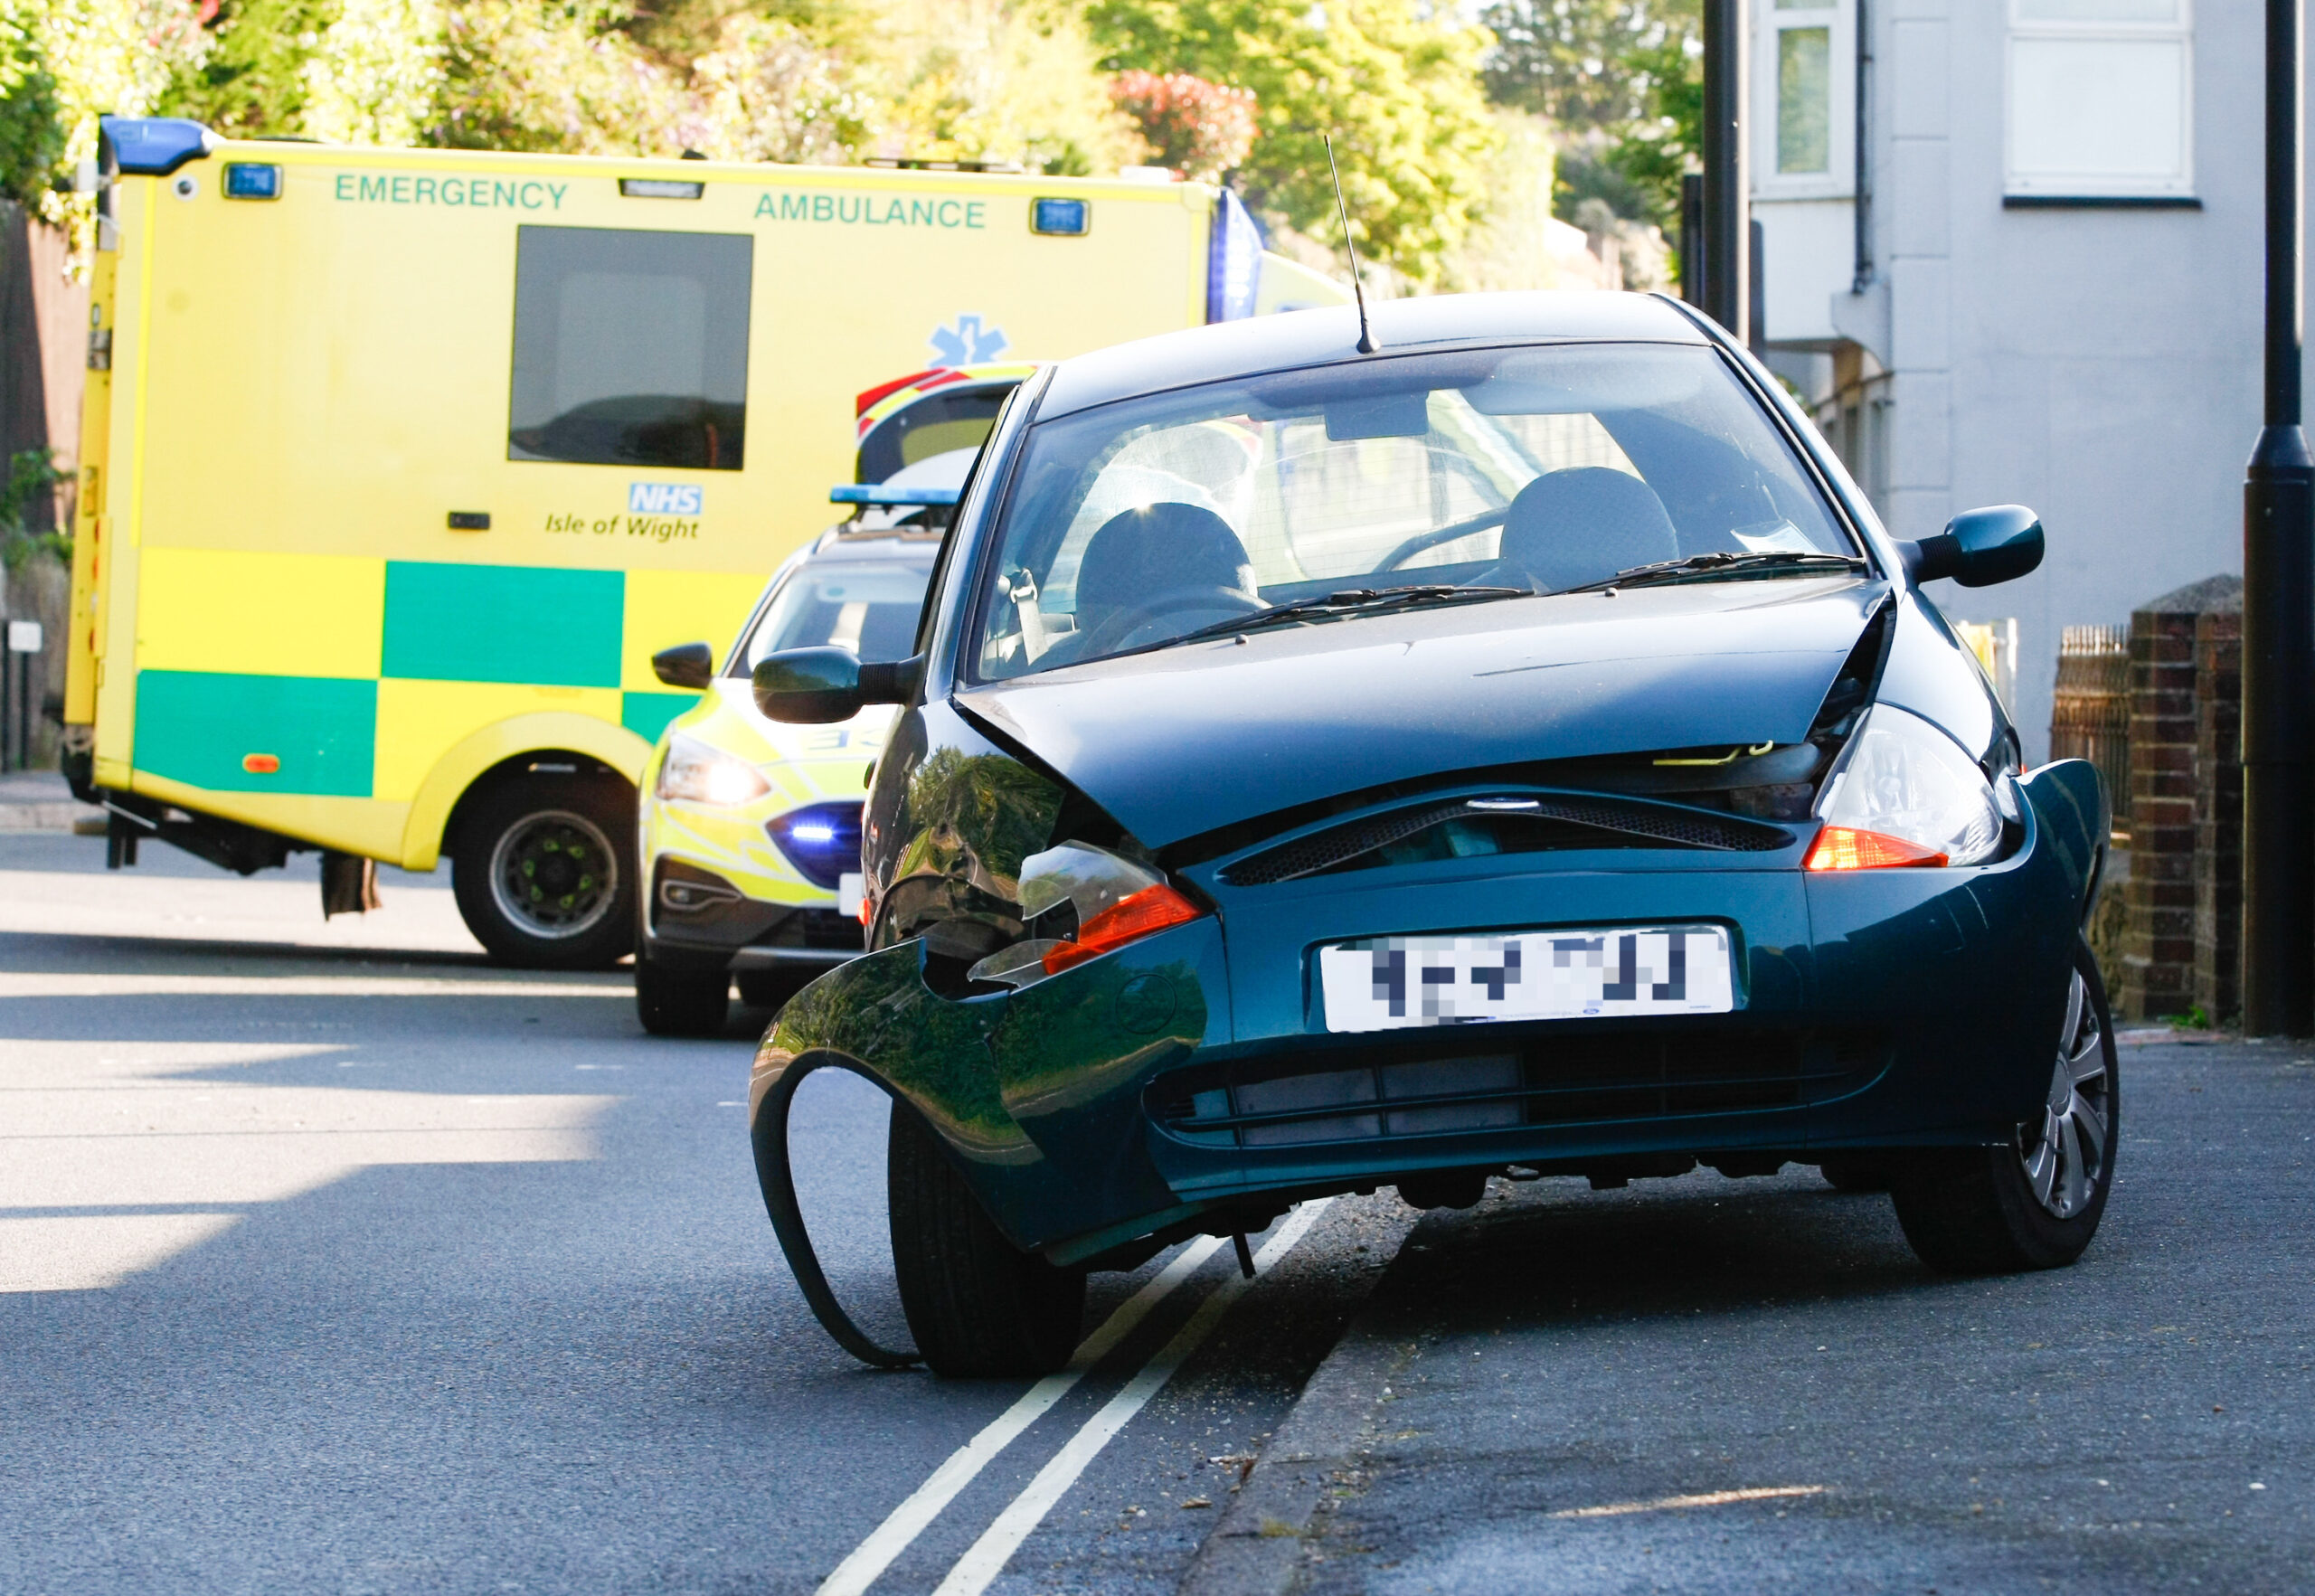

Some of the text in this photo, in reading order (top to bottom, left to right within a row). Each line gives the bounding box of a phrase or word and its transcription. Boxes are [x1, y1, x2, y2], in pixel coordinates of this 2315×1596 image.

[335, 175, 987, 229] EMERGENCY AMBULANCE
[630, 484, 701, 514] NHS
[544, 513, 700, 543] Isle of Wight
